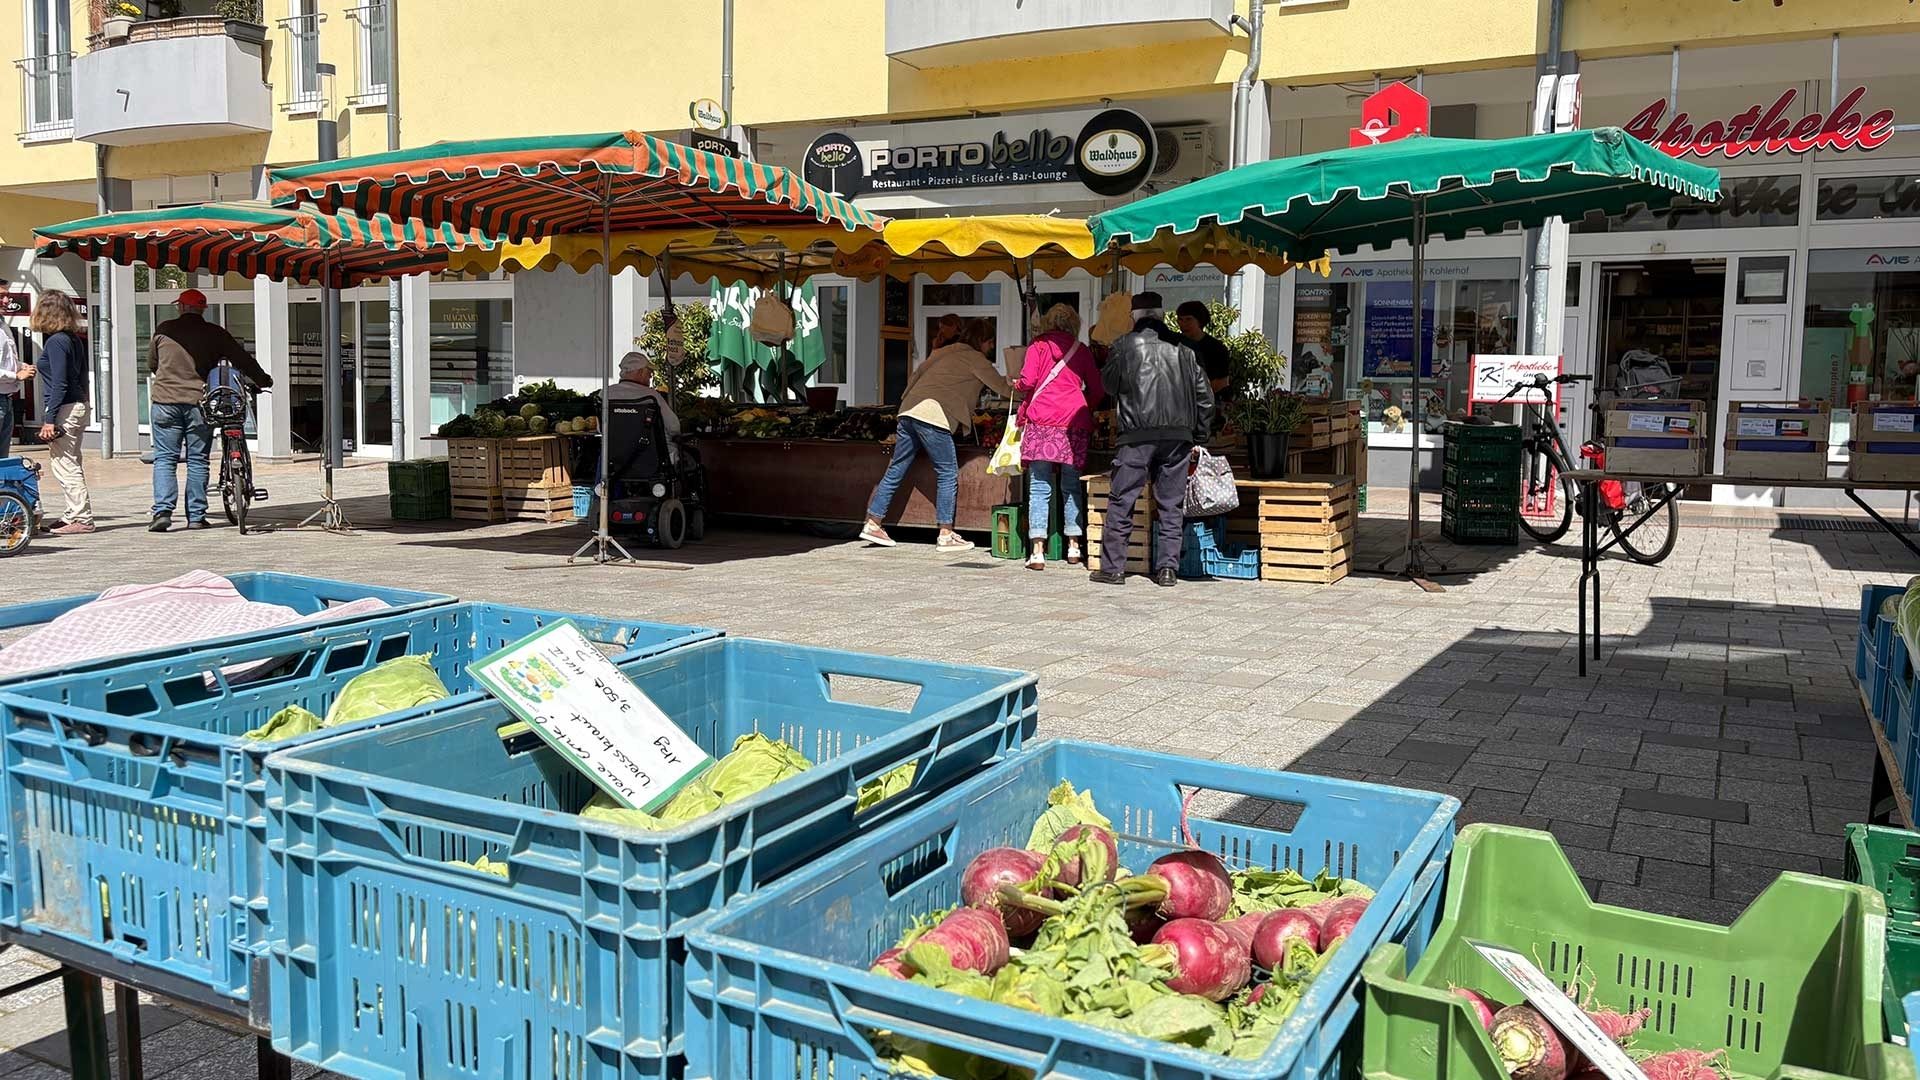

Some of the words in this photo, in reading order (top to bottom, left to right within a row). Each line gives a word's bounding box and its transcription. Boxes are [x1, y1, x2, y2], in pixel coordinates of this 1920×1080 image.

[1623, 86, 1896, 160] Apotheke
[697, 140, 732, 157] PORTO
[815, 143, 852, 155] PORTO
[871, 142, 985, 171] PORTO
[992, 128, 1072, 165] bello
[821, 151, 846, 163] bello
[1089, 149, 1138, 162] Waldhaus
[872, 178, 921, 189] Restaurant
[928, 175, 964, 186] Pizzeria
[971, 171, 1004, 184] Eiscafé
[1012, 169, 1068, 182] Bar-Lounge
[1428, 264, 1471, 276] Kohlerhof
[1187, 273, 1221, 283] Apotheke
[1507, 360, 1553, 372] Apotheke
[570, 711, 652, 790] Weisskraut
